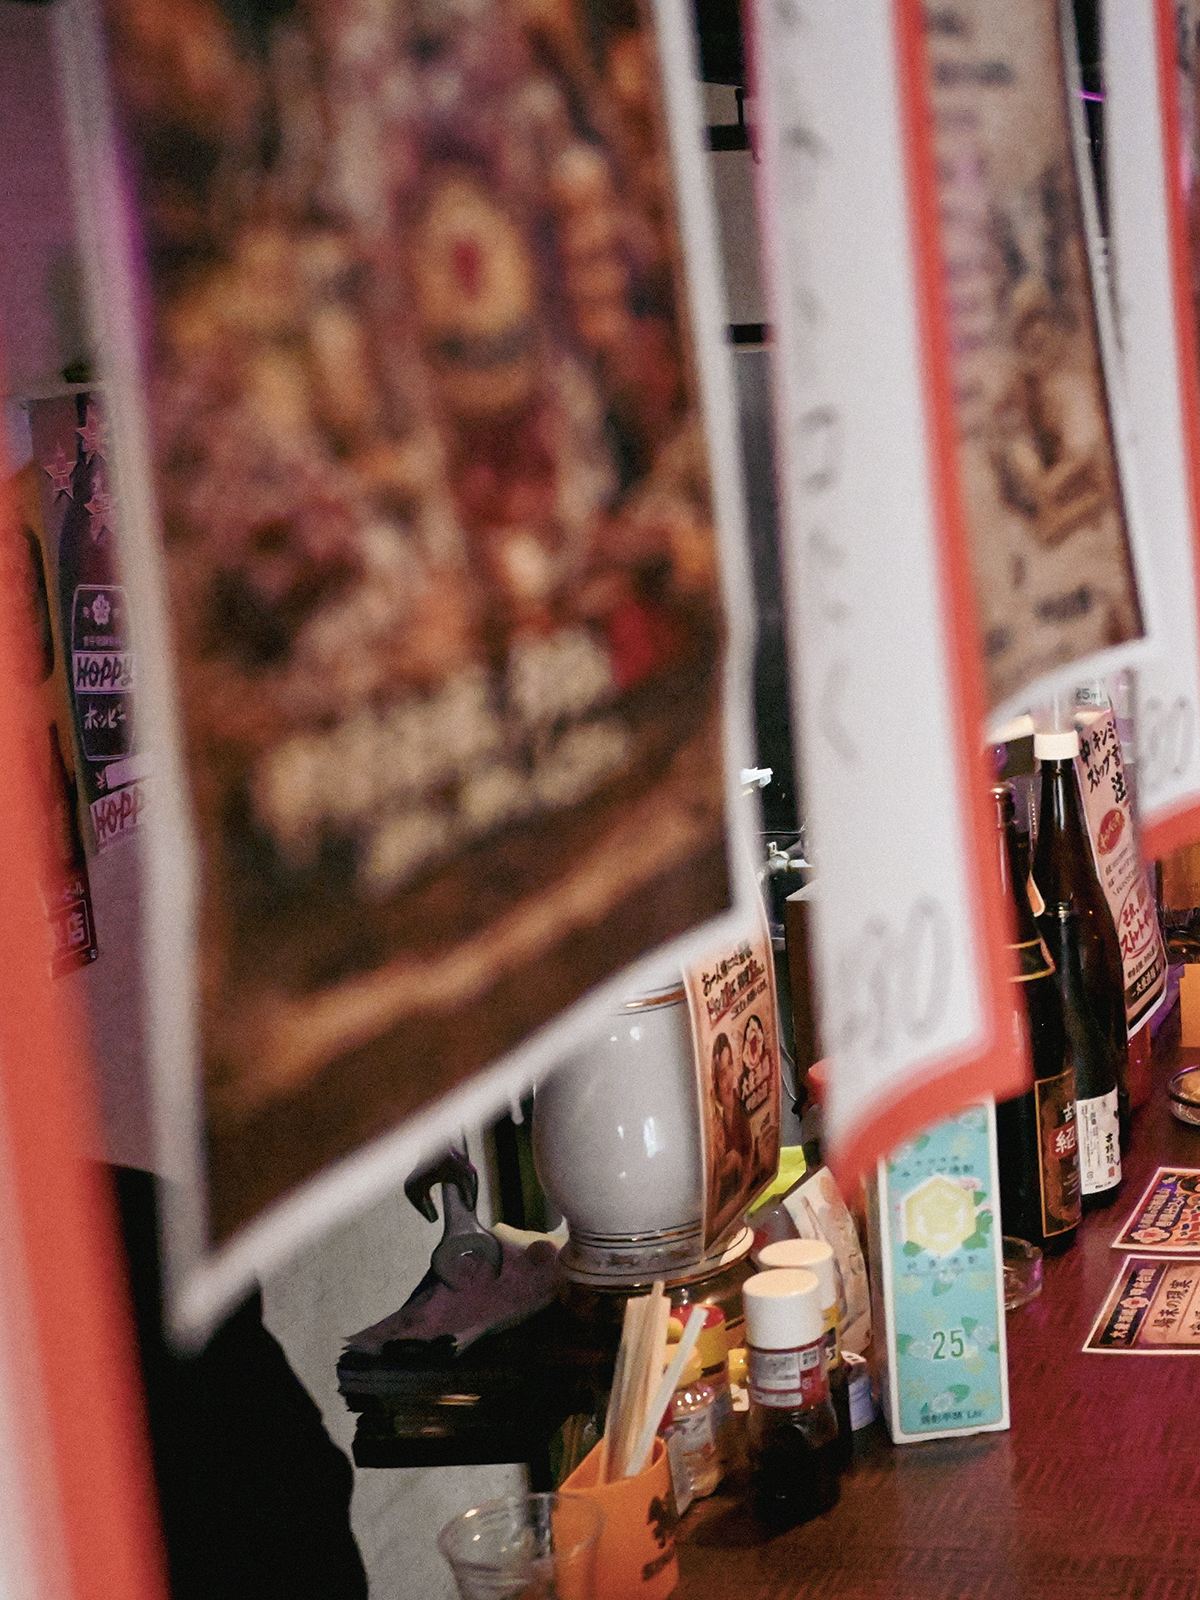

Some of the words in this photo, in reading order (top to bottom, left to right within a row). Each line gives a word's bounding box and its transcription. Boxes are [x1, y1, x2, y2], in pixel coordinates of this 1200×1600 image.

[1150, 1279, 1193, 1328] 場末の現実
[932, 1328, 965, 1360] 25
